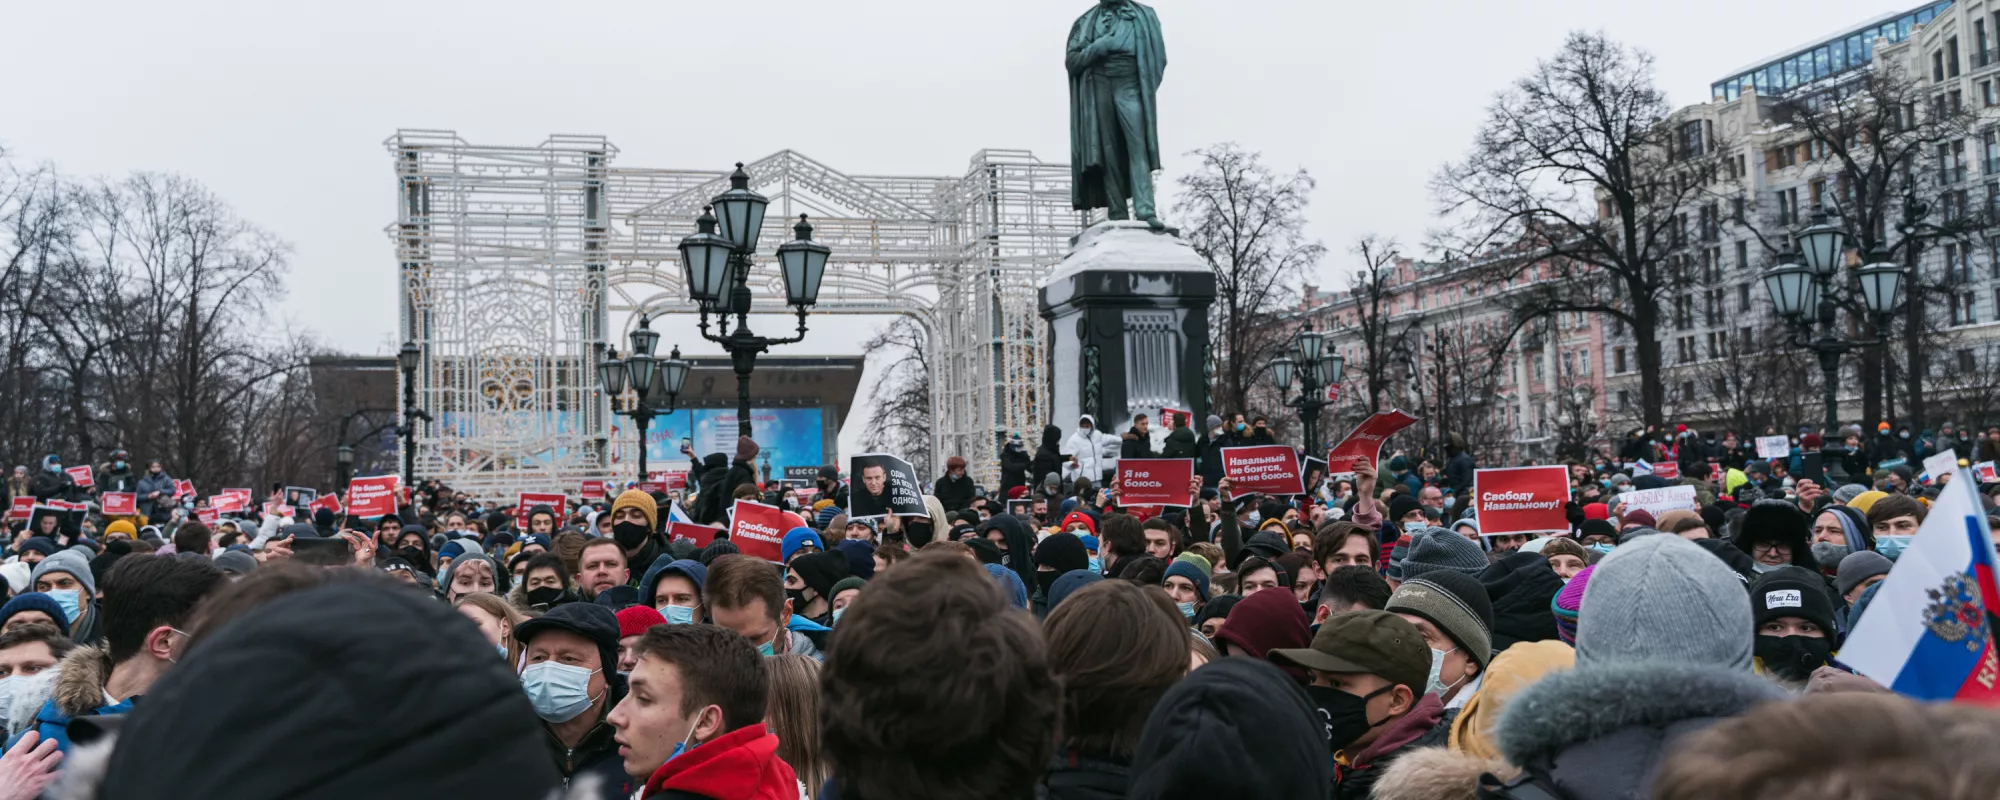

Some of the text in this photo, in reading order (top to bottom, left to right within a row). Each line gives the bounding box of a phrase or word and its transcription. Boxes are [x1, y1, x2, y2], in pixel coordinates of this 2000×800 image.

[1229, 453, 1286, 466] Навальный
[1124, 469, 1150, 479] Я не
[1230, 465, 1283, 475] не боится,
[891, 478, 901, 486] ЗА
[1247, 474, 1260, 482] не
[1261, 472, 1294, 480] боюсь
[1124, 478, 1162, 488] боюсь
[892, 487, 898, 495] И
[1483, 490, 1534, 502] Свободу
[892, 497, 919, 506] ОДНОГО
[1483, 499, 1560, 511] Навальному!
[737, 520, 780, 536] Свободу
[736, 528, 783, 544] Навально
[1768, 593, 1800, 603] New Era
